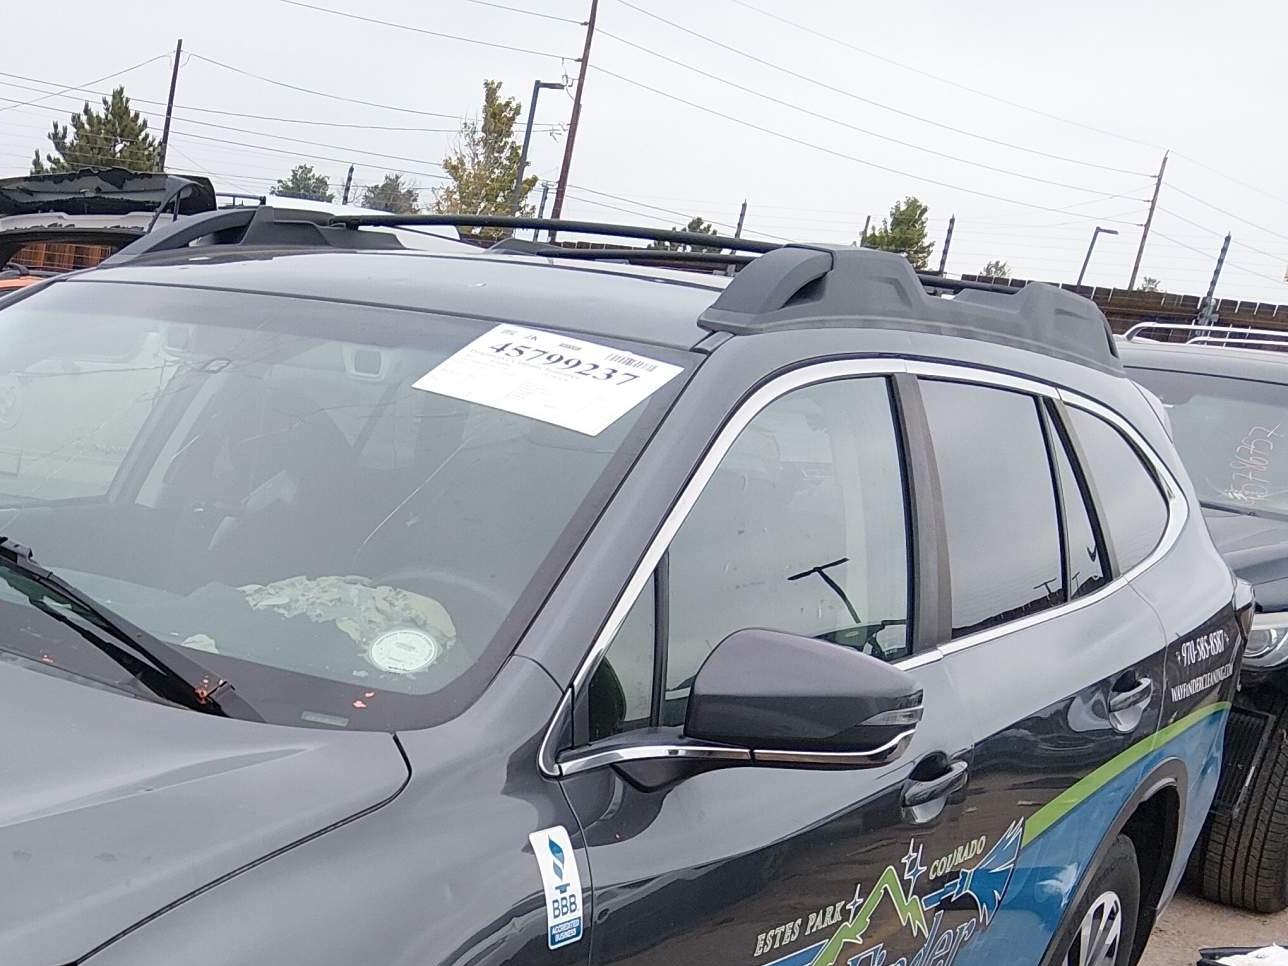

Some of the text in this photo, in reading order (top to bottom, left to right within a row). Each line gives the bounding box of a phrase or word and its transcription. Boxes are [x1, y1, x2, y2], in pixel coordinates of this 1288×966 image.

[488, 341, 640, 386] 45799237
[552, 894, 577, 919] BBB
[754, 899, 846, 957] ESTES PARK
